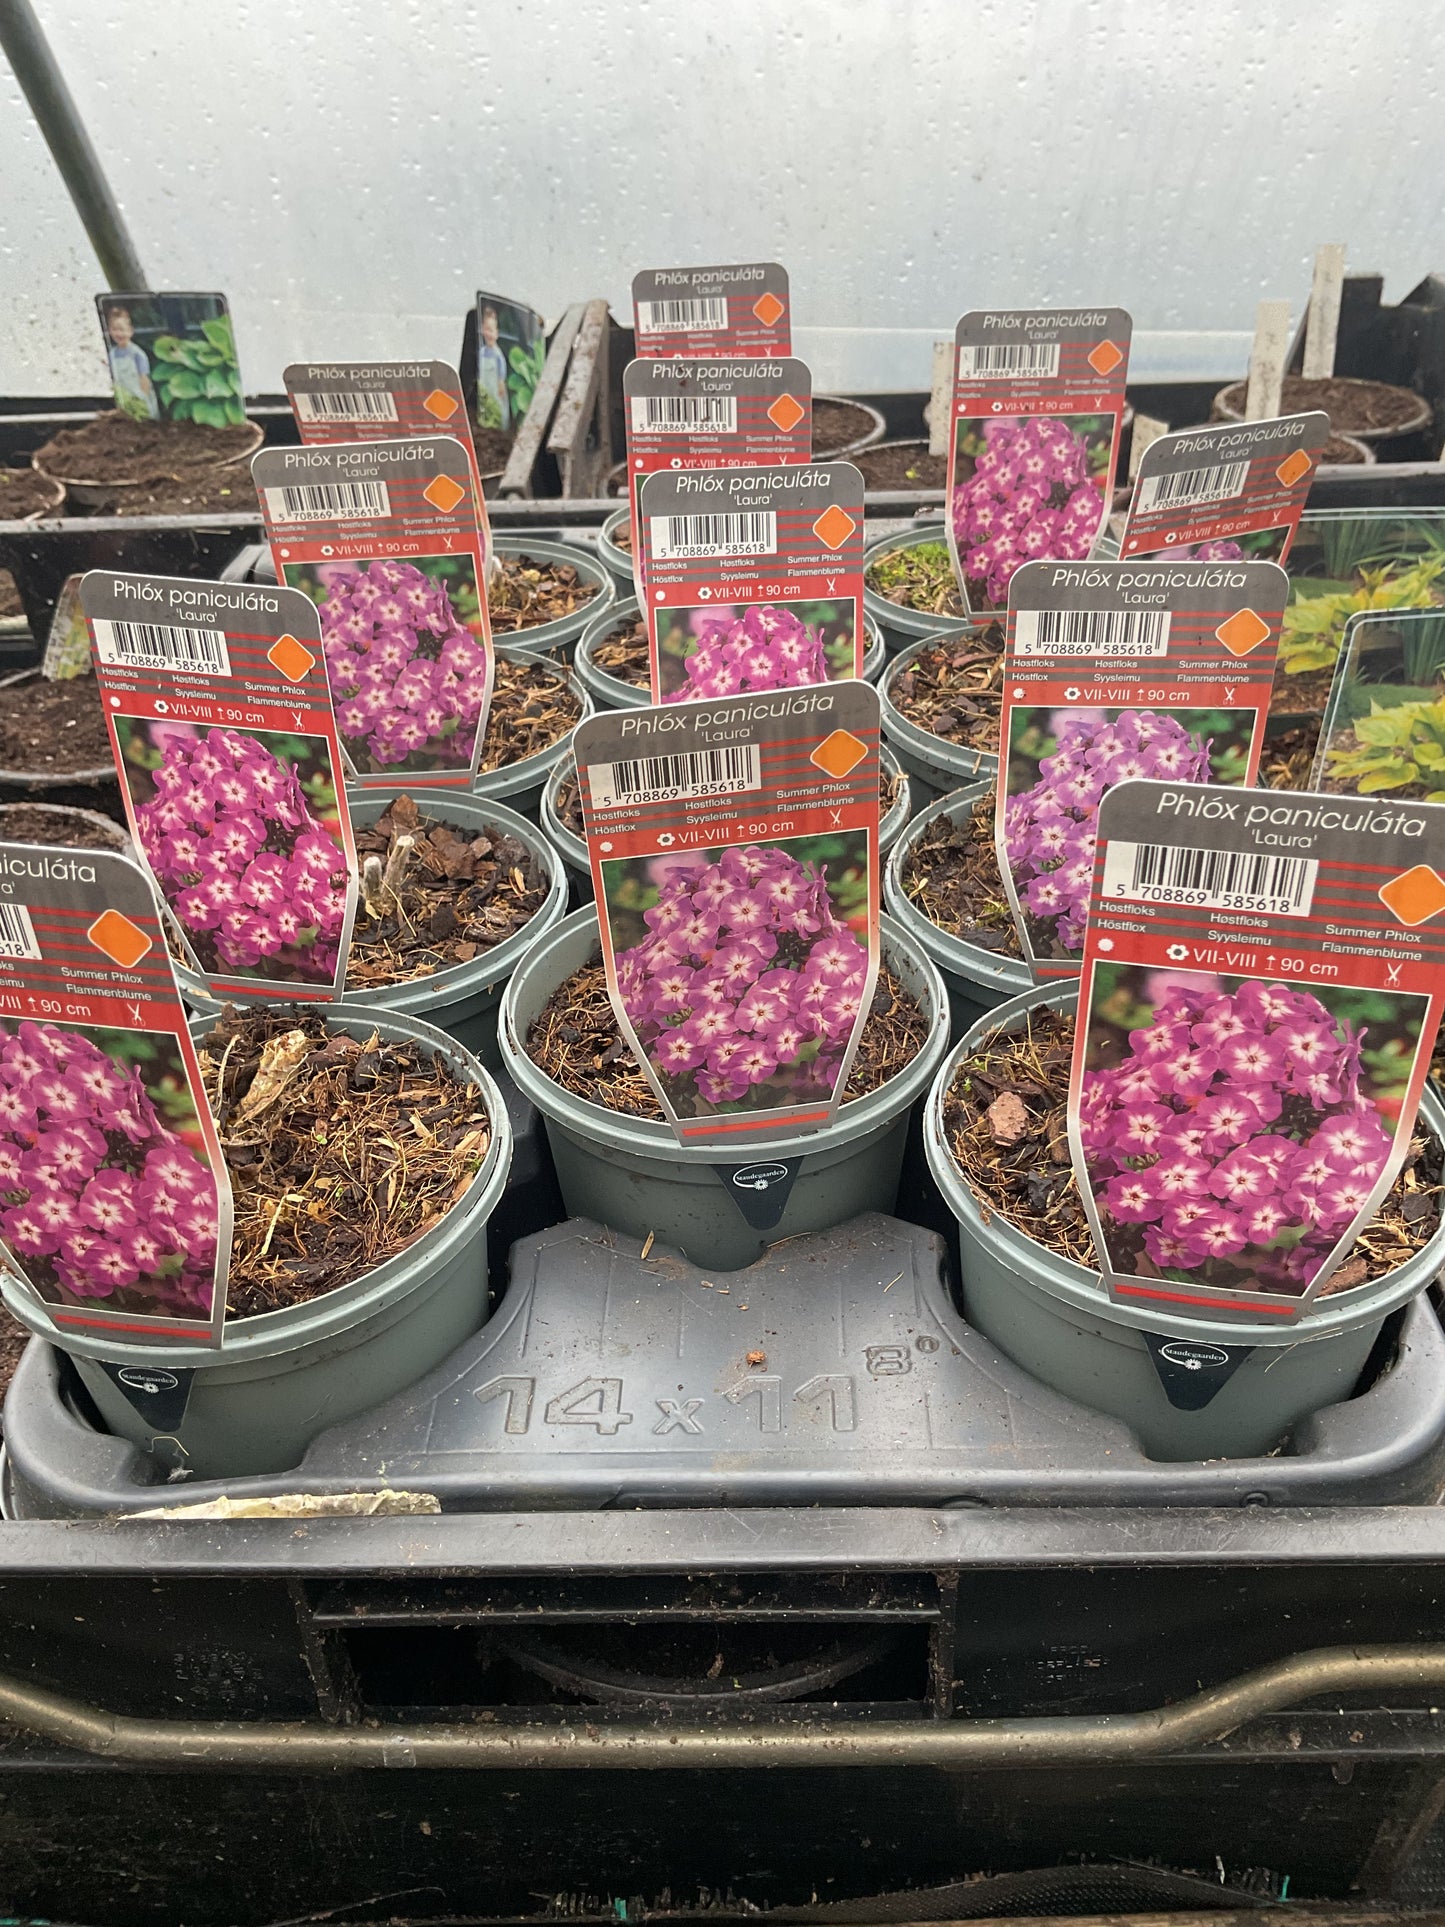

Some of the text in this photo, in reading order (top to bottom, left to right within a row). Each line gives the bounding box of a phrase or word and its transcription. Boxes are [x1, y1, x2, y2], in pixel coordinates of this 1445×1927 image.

[656, 267, 763, 285] Phlóx paniculáta
[984, 313, 1106, 330] Phlóx paniculáta
[309, 366, 429, 380] Phlóx paniculáta
[697, 363, 782, 381] paniculáta
[978, 370, 1009, 378] 708869
[1017, 369, 1048, 377] 585618
[701, 382, 733, 391] 'Laura'
[640, 423, 727, 432] 5 708869 585618
[1173, 421, 1306, 455] Phlóx paniculáta
[286, 446, 434, 468] Phlóx paniculáta
[343, 466, 379, 477] 'Laura'
[728, 460, 740, 469] 90
[677, 470, 830, 495] Phlóx paniculáta
[734, 494, 772, 505] 'Laura'
[1158, 497, 1191, 509] 708869
[1199, 490, 1232, 502] 585618
[279, 508, 380, 522] 5 708869 585618
[1180, 527, 1210, 540] VII-VIII
[1223, 523, 1233, 532] 90
[336, 544, 373, 555] VII-VIII
[386, 543, 400, 552] 90
[661, 543, 765, 557] 5 708869 585618
[652, 562, 687, 570] Høstfloks
[720, 559, 755, 567] Høstfloks
[788, 554, 842, 564] Summer Phlox
[653, 575, 683, 583] Höstflox
[721, 572, 759, 582] Syysleimu
[788, 568, 845, 577] Flammenblume
[1051, 569, 1247, 591] Phlóx paniculáta
[113, 581, 278, 612] Phlóx paniculáta
[714, 586, 800, 599] VII-VIII 90 cm
[1122, 592, 1169, 603] 'Laura'
[176, 608, 217, 622] 'Laura'
[1025, 644, 1152, 655] 5 708869 585618
[107, 652, 219, 673] 5 708869 585618
[1013, 659, 1055, 667] Høstfloks
[1095, 660, 1137, 668] Høstfloks
[1178, 660, 1246, 669] Summer Phlox
[100, 666, 138, 678] Høstfloks
[1094, 673, 1141, 683] Syysleimu
[1177, 674, 1247, 683] Flammenblume
[103, 680, 136, 691] Höstflox
[172, 674, 210, 685] Høstfloks
[175, 688, 216, 700] Syysleimu
[245, 682, 305, 695] Summer Phlox
[1085, 689, 1189, 701] VII-VIII 90 cm
[248, 696, 311, 710] Flammenblume
[171, 703, 264, 724] VII-VIII 90 cm
[622, 694, 834, 736] Phlóx paniculáta
[702, 725, 753, 742] 'Laura'
[604, 780, 745, 807] 5 708869 585618
[777, 783, 850, 798] Summer Phlox
[685, 798, 732, 810] Høstfloks
[777, 797, 854, 812] Flammenblume
[593, 809, 640, 821] Høstfloks
[687, 812, 737, 825] Syysleimu
[1157, 796, 1427, 835] Phlóx paniculáta
[595, 824, 636, 834] Höstflox
[678, 822, 794, 843] VII-VIII 90 cm
[1252, 830, 1317, 848] 'Laura'
[0, 853, 96, 883] iculáta
[1116, 884, 1290, 913] 5 708869 585618
[1099, 902, 1155, 916] Høstfloks
[1098, 919, 1146, 933] Höstflox
[1211, 913, 1268, 927] Høstfloks
[1208, 930, 1272, 945] Syysleimu
[1325, 924, 1421, 942] Summer Phlox
[1322, 942, 1422, 961] Flammenblume
[1194, 949, 1338, 976] VII-VIII 90 cm
[61, 967, 144, 984] Summer Phlox
[66, 983, 152, 1001] Flammenblume
[40, 999, 91, 1017] 90 cm
[473, 1375, 858, 1435] 14 x 11
